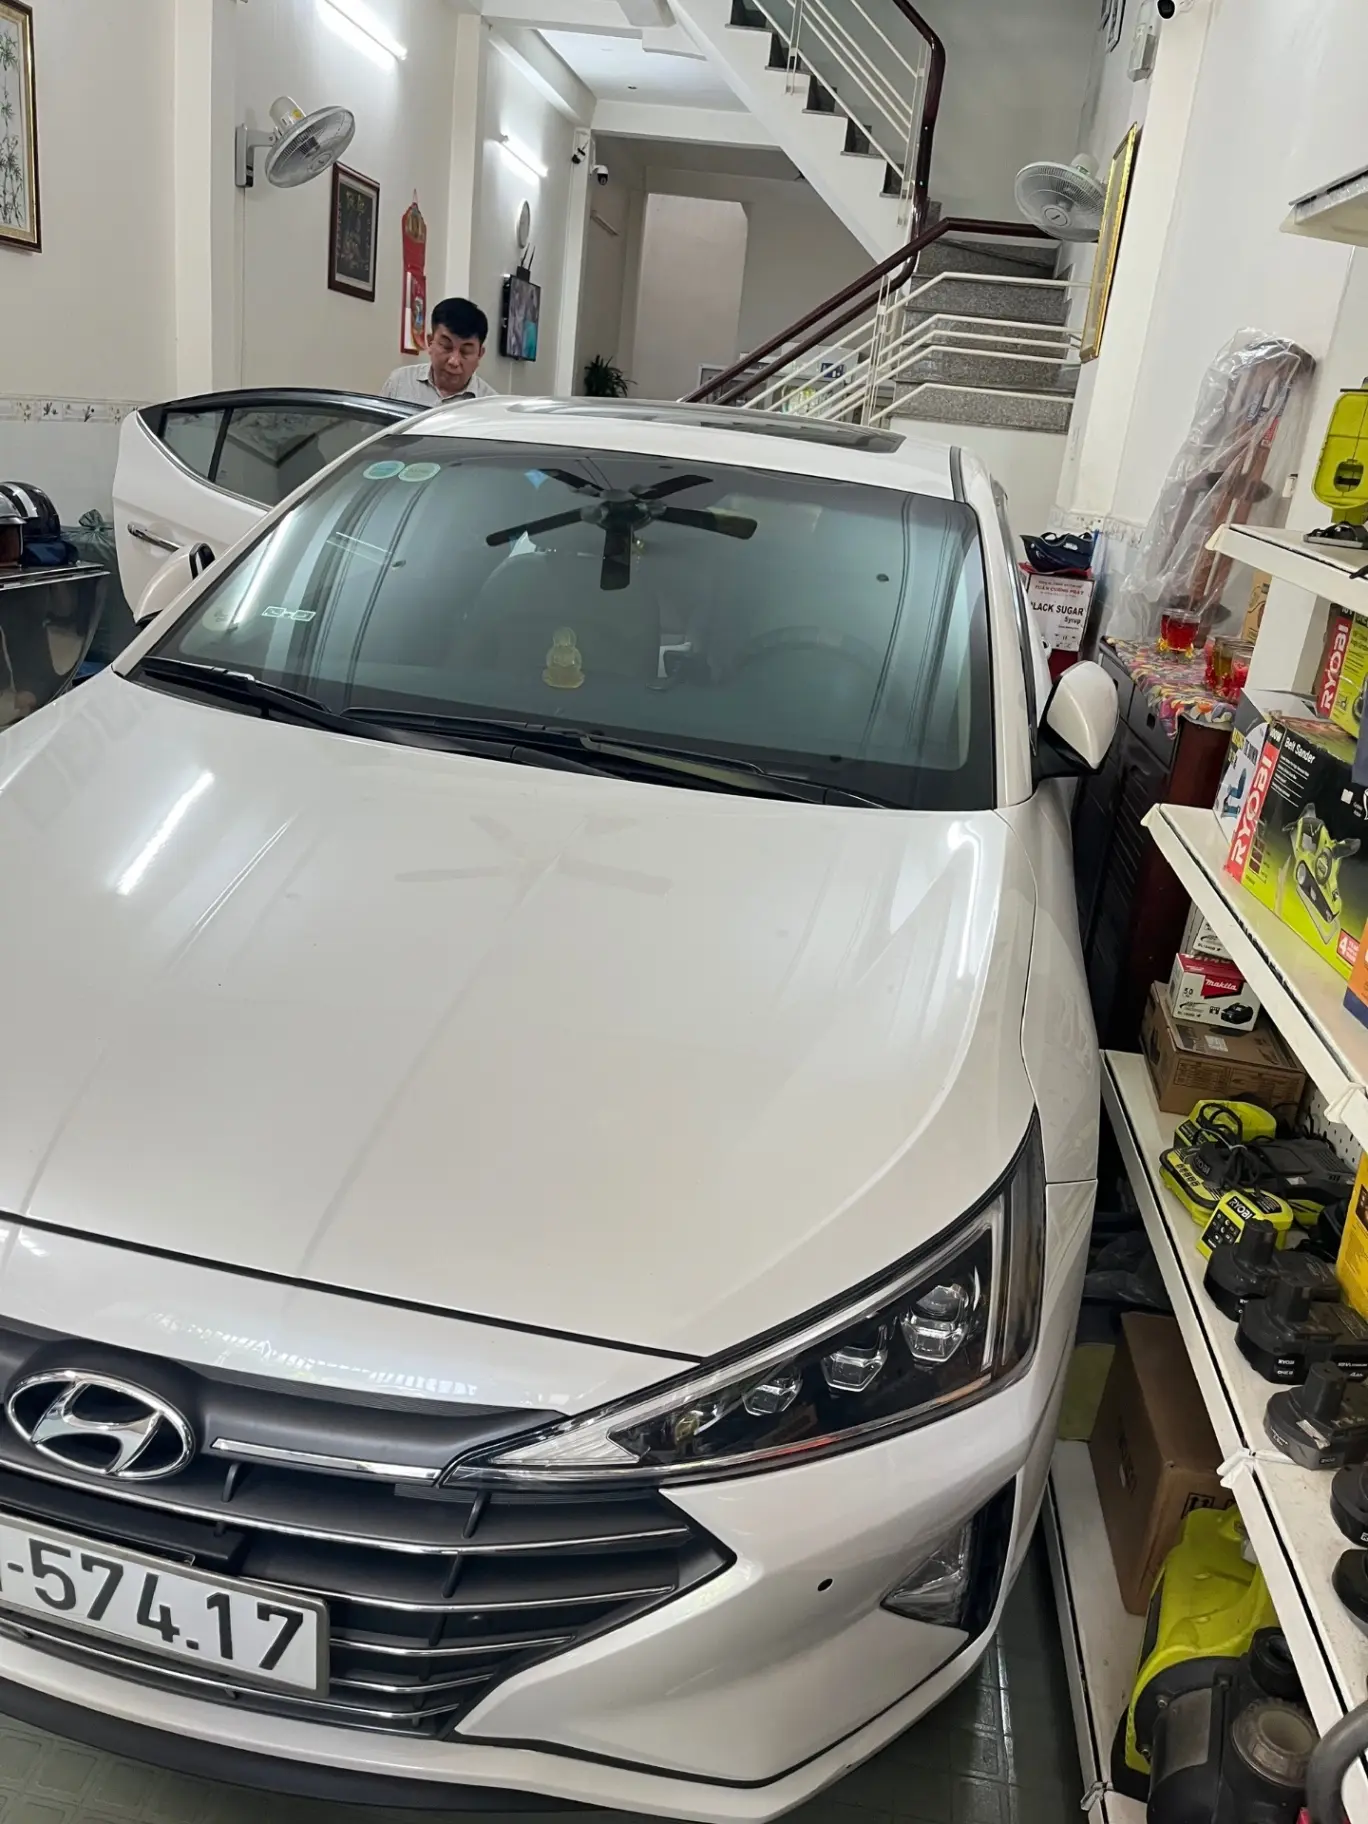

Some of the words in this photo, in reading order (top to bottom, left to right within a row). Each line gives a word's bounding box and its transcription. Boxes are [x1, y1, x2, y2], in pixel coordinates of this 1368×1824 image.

[1030, 600, 1054, 613] LACK
[1056, 604, 1084, 616] SUGAR
[1063, 616, 1081, 625] Syrup
[1320, 624, 1349, 709] RYOBI
[1284, 736, 1296, 753] Belt
[1294, 744, 1316, 764] Sander
[1230, 751, 1273, 866] RYOBI
[1229, 1197, 1253, 1220] RYOBI
[0, 1538, 304, 1671] -574.17
